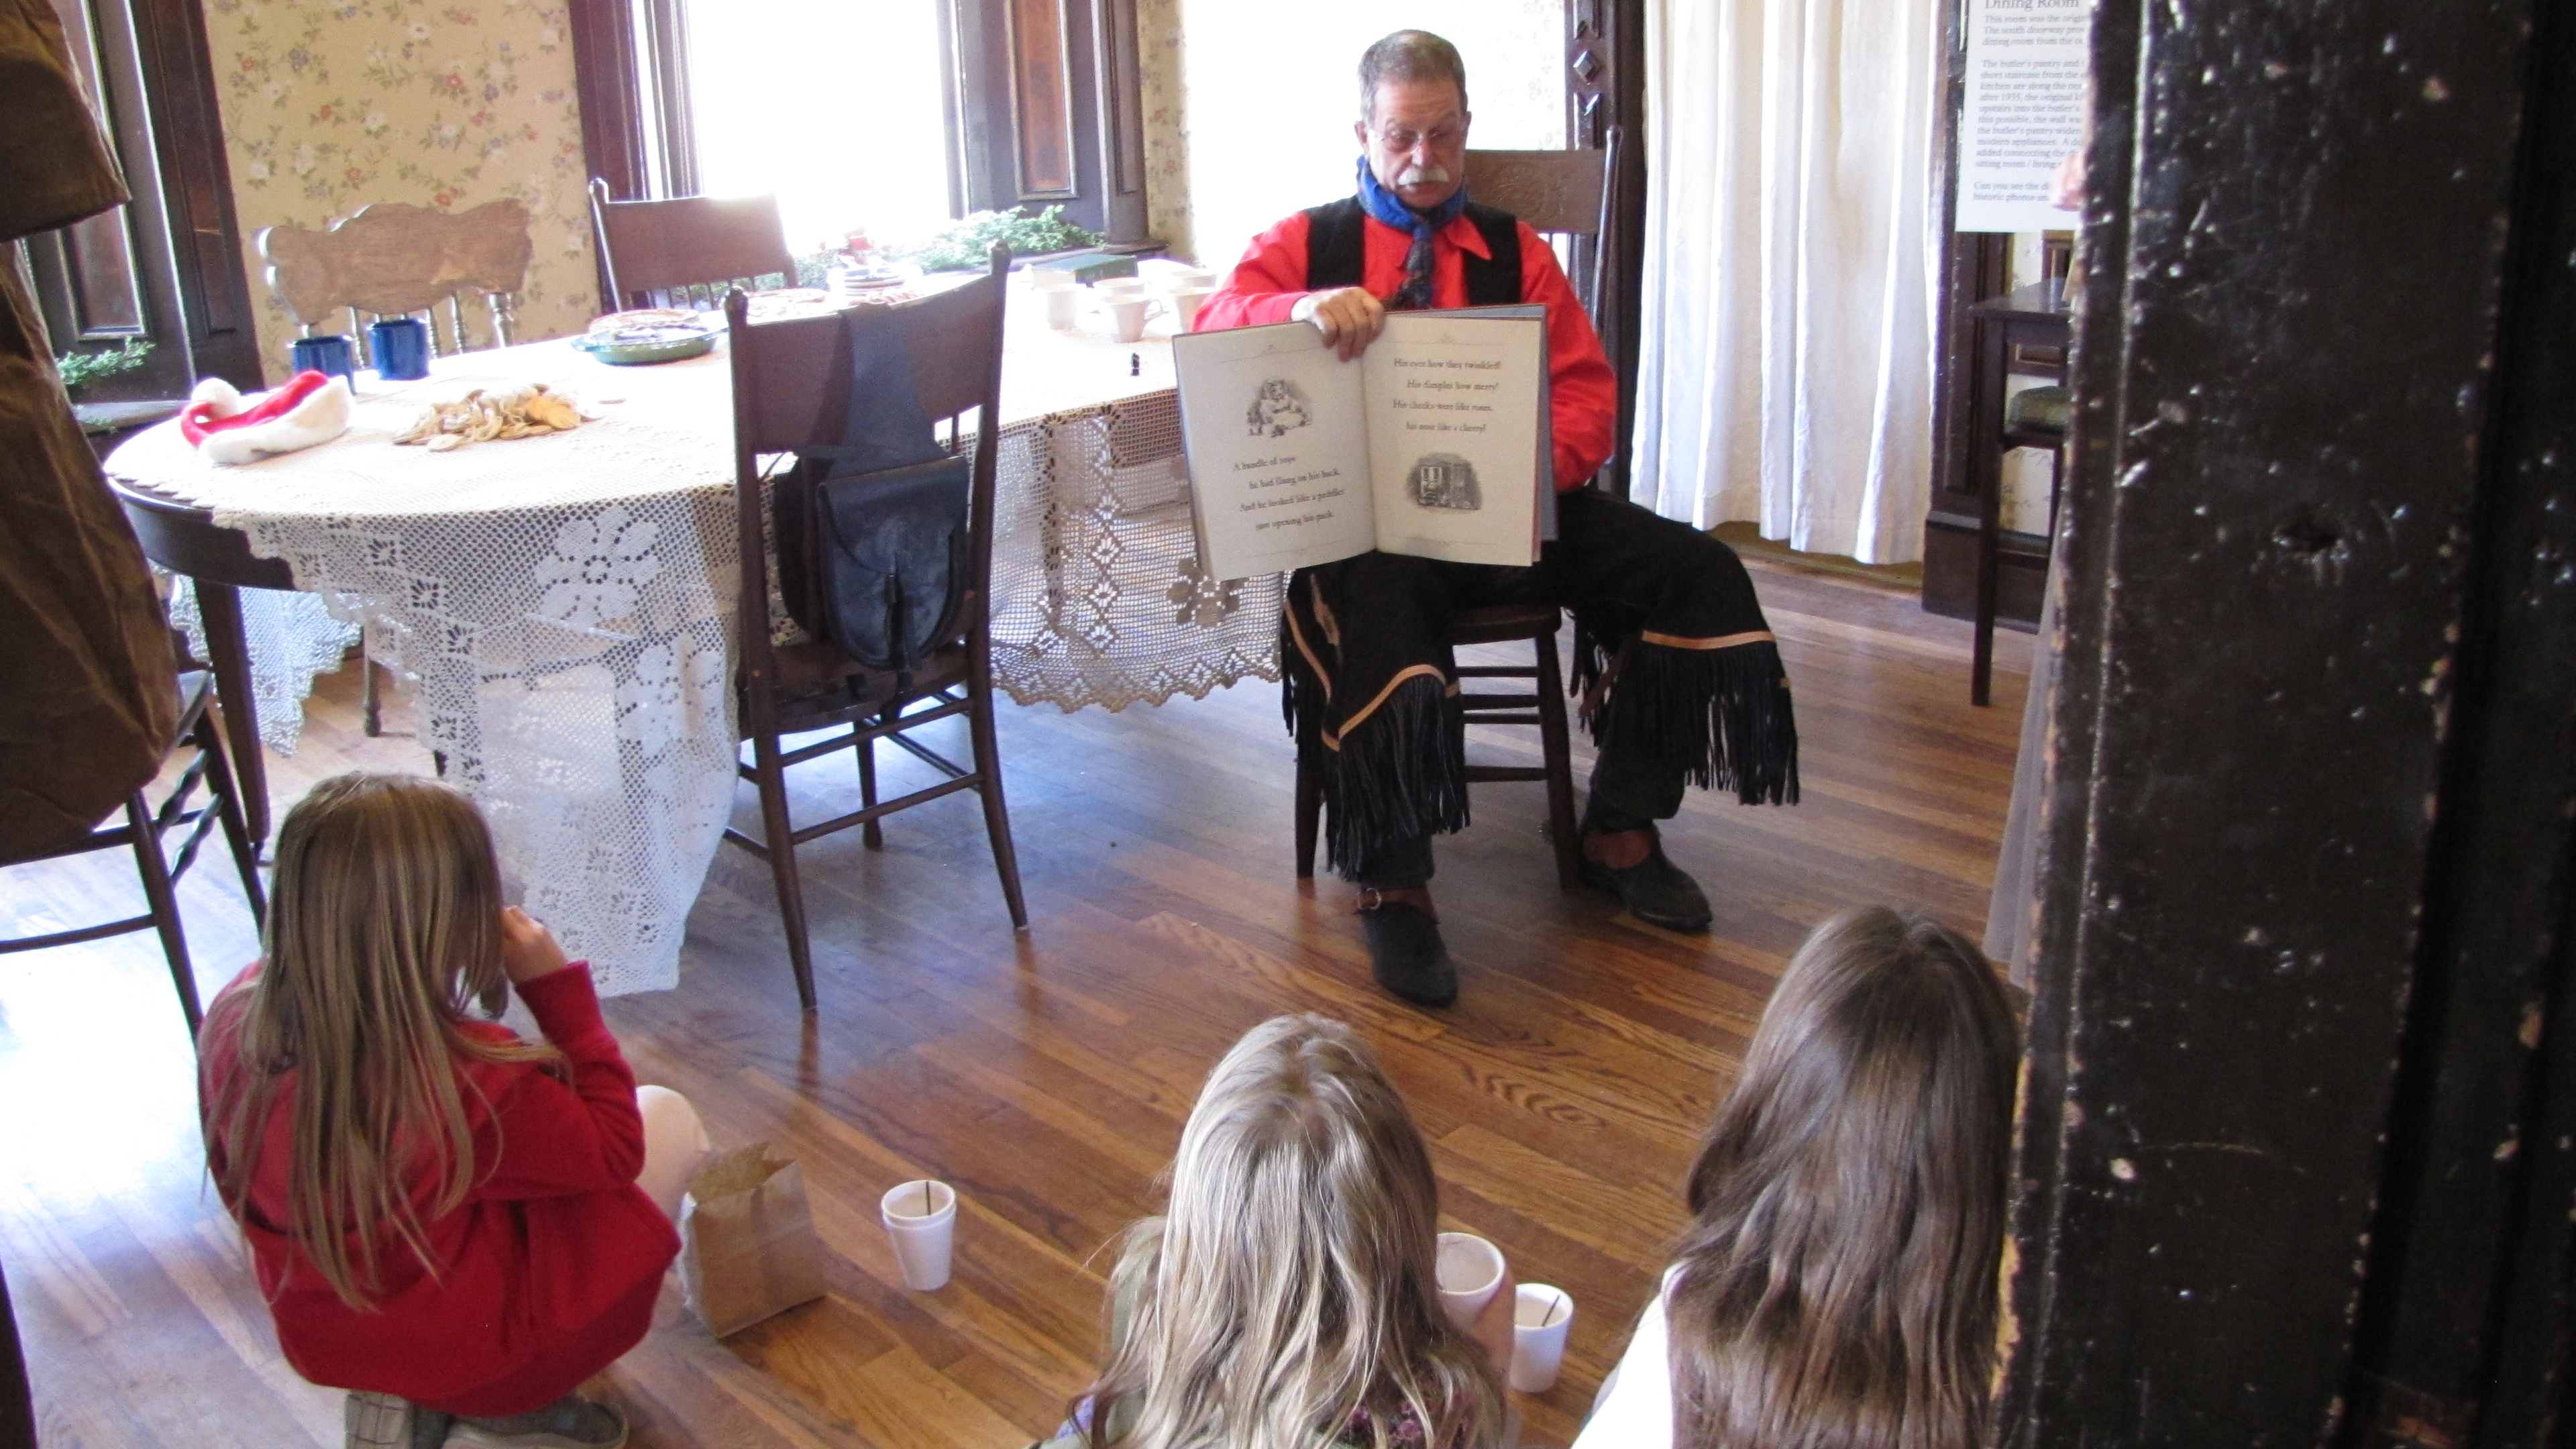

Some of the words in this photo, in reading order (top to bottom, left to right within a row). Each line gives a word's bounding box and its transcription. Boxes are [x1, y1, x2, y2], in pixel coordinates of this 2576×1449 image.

[2046, 15, 2060, 23] the
[2027, 27, 2064, 36] doorway
[1982, 38, 2009, 47] dining
[1982, 60, 1998, 68] The
[2033, 61, 2061, 69] pantry
[2042, 70, 2062, 78] from
[1980, 82, 2011, 90] kitchen
[2027, 83, 2051, 91] along
[1980, 93, 1998, 101] after
[2025, 93, 2038, 101] the
[2039, 93, 2072, 103] original
[1978, 105, 2011, 113] upstairs
[2013, 105, 2030, 113] into
[2025, 128, 2053, 136] pantry
[2003, 150, 2051, 158] connecting
[1975, 160, 2001, 169] sitting
[2033, 160, 2057, 170] living
[1974, 182, 1992, 190] Can
[1992, 183, 2008, 191] you
[2025, 182, 2039, 190] the
[1973, 193, 2005, 201] historic
[2005, 193, 2035, 203] photos
[1394, 358, 1407, 367] His
[1428, 359, 1444, 368] how
[1446, 360, 1462, 370] they
[1407, 379, 1421, 388] His
[1423, 380, 1453, 392] dimples
[1454, 380, 1471, 389] how
[1393, 399, 1407, 409] His
[1409, 400, 1435, 409] cheeks
[1454, 402, 1470, 411] like
[1437, 423, 1452, 431] like
[1233, 462, 1241, 471] A
[1242, 458, 1268, 470] bundle
[1269, 457, 1278, 465] of
[1248, 481, 1259, 490] he
[1259, 478, 1274, 487] had
[1275, 476, 1297, 486] flung
[1308, 472, 1320, 480] his
[1239, 501, 1256, 512] And
[1256, 500, 1267, 508] he
[1268, 496, 1295, 507] looked
[1295, 493, 1311, 503] like
[1271, 518, 1302, 529] opening
[1303, 514, 1315, 522] his
